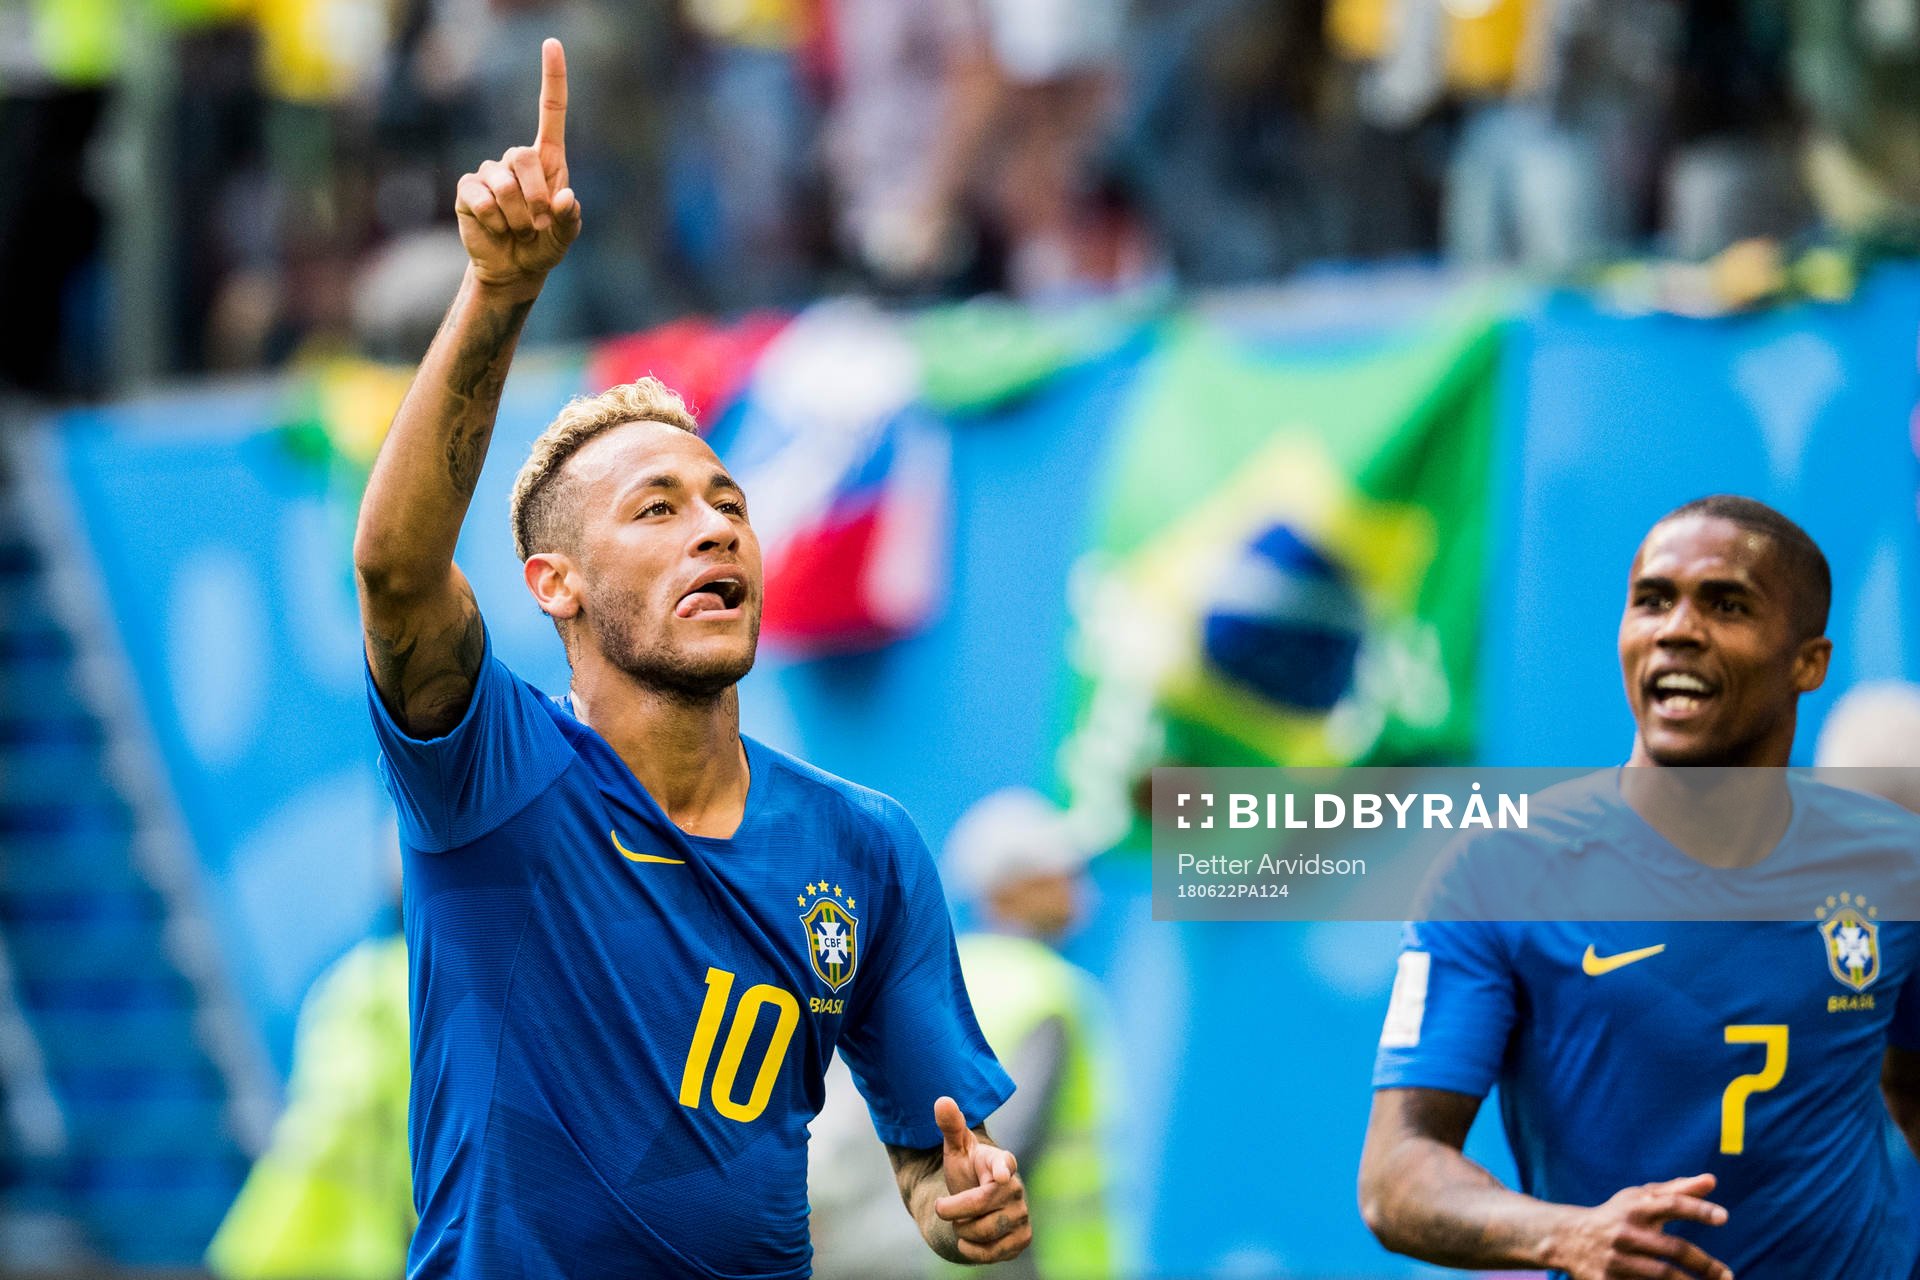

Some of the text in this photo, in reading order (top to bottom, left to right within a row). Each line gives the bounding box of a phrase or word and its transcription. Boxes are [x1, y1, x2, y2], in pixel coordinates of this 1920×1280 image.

[824, 937, 841, 948] CBF
[679, 966, 800, 1123] 10
[1720, 1024, 1789, 1155] 7
